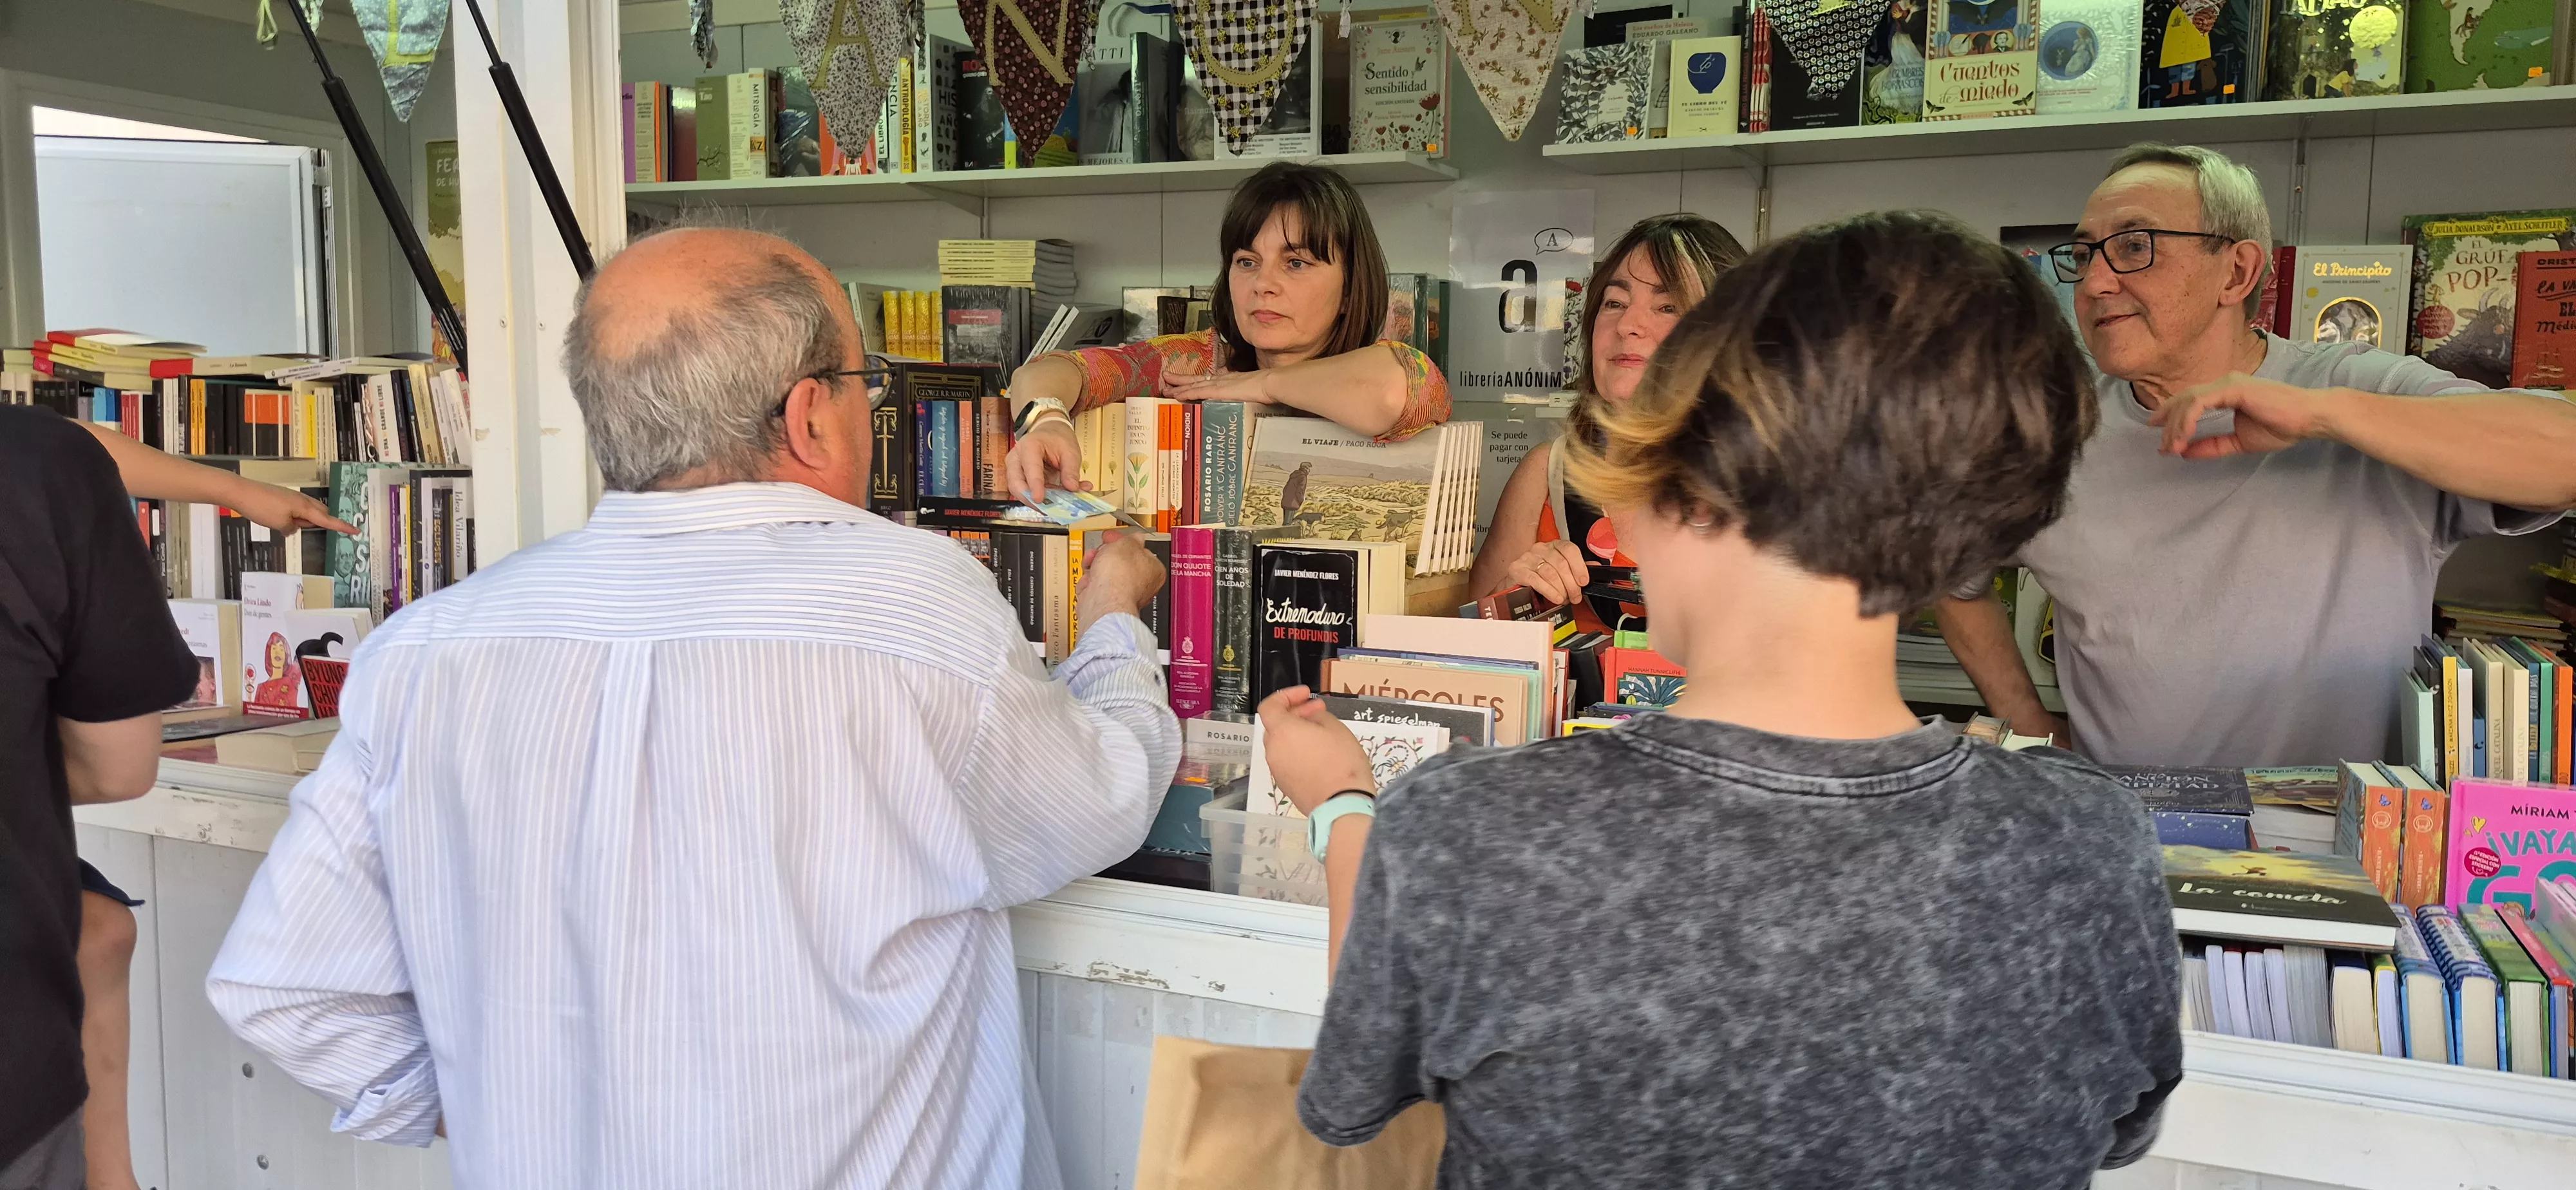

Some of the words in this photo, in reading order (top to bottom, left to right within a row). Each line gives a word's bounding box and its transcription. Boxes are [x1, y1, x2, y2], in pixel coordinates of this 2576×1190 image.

[1364, 62, 1409, 80] Sentido
[1940, 59, 2020, 82] Cuentos
[1364, 79, 1427, 95] sensibilidad
[1960, 78, 2019, 102] miedo
[1547, 232, 1558, 247] A
[2471, 240, 2483, 249] EL
[2313, 262, 2327, 277] El
[2329, 261, 2392, 279] Principito
[1227, 413, 1238, 472] CANFRANC
[1491, 431, 1501, 439] Se
[1504, 431, 1528, 440] puede
[1204, 435, 1213, 464] RARO
[1215, 426, 1226, 484] CANFRANC
[1489, 443, 1512, 453] pagar
[1497, 455, 1521, 464] tarjeta
[1204, 467, 1213, 513] ROSARIO
[1227, 474, 1236, 500] SOBRE
[455, 491, 463, 513] Idea
[1227, 502, 1236, 526] CIELO
[455, 516, 464, 558] Vilariño
[1274, 569, 1292, 578] JAVIER
[1293, 569, 1319, 579] MENÉNDEZ
[1320, 572, 1340, 580] FLORES
[1265, 597, 1345, 625] Extremoduro
[1274, 627, 1285, 639] DE
[1288, 627, 1340, 643] PROFUNDIS
[1353, 707, 1374, 722] art
[1377, 710, 1441, 727] spiegelman
[1207, 732, 1250, 742] ROSARIO
[2510, 803, 2571, 820] MÍRIAM
[2178, 882, 2222, 894] La
[2231, 889, 2347, 905] cometa
